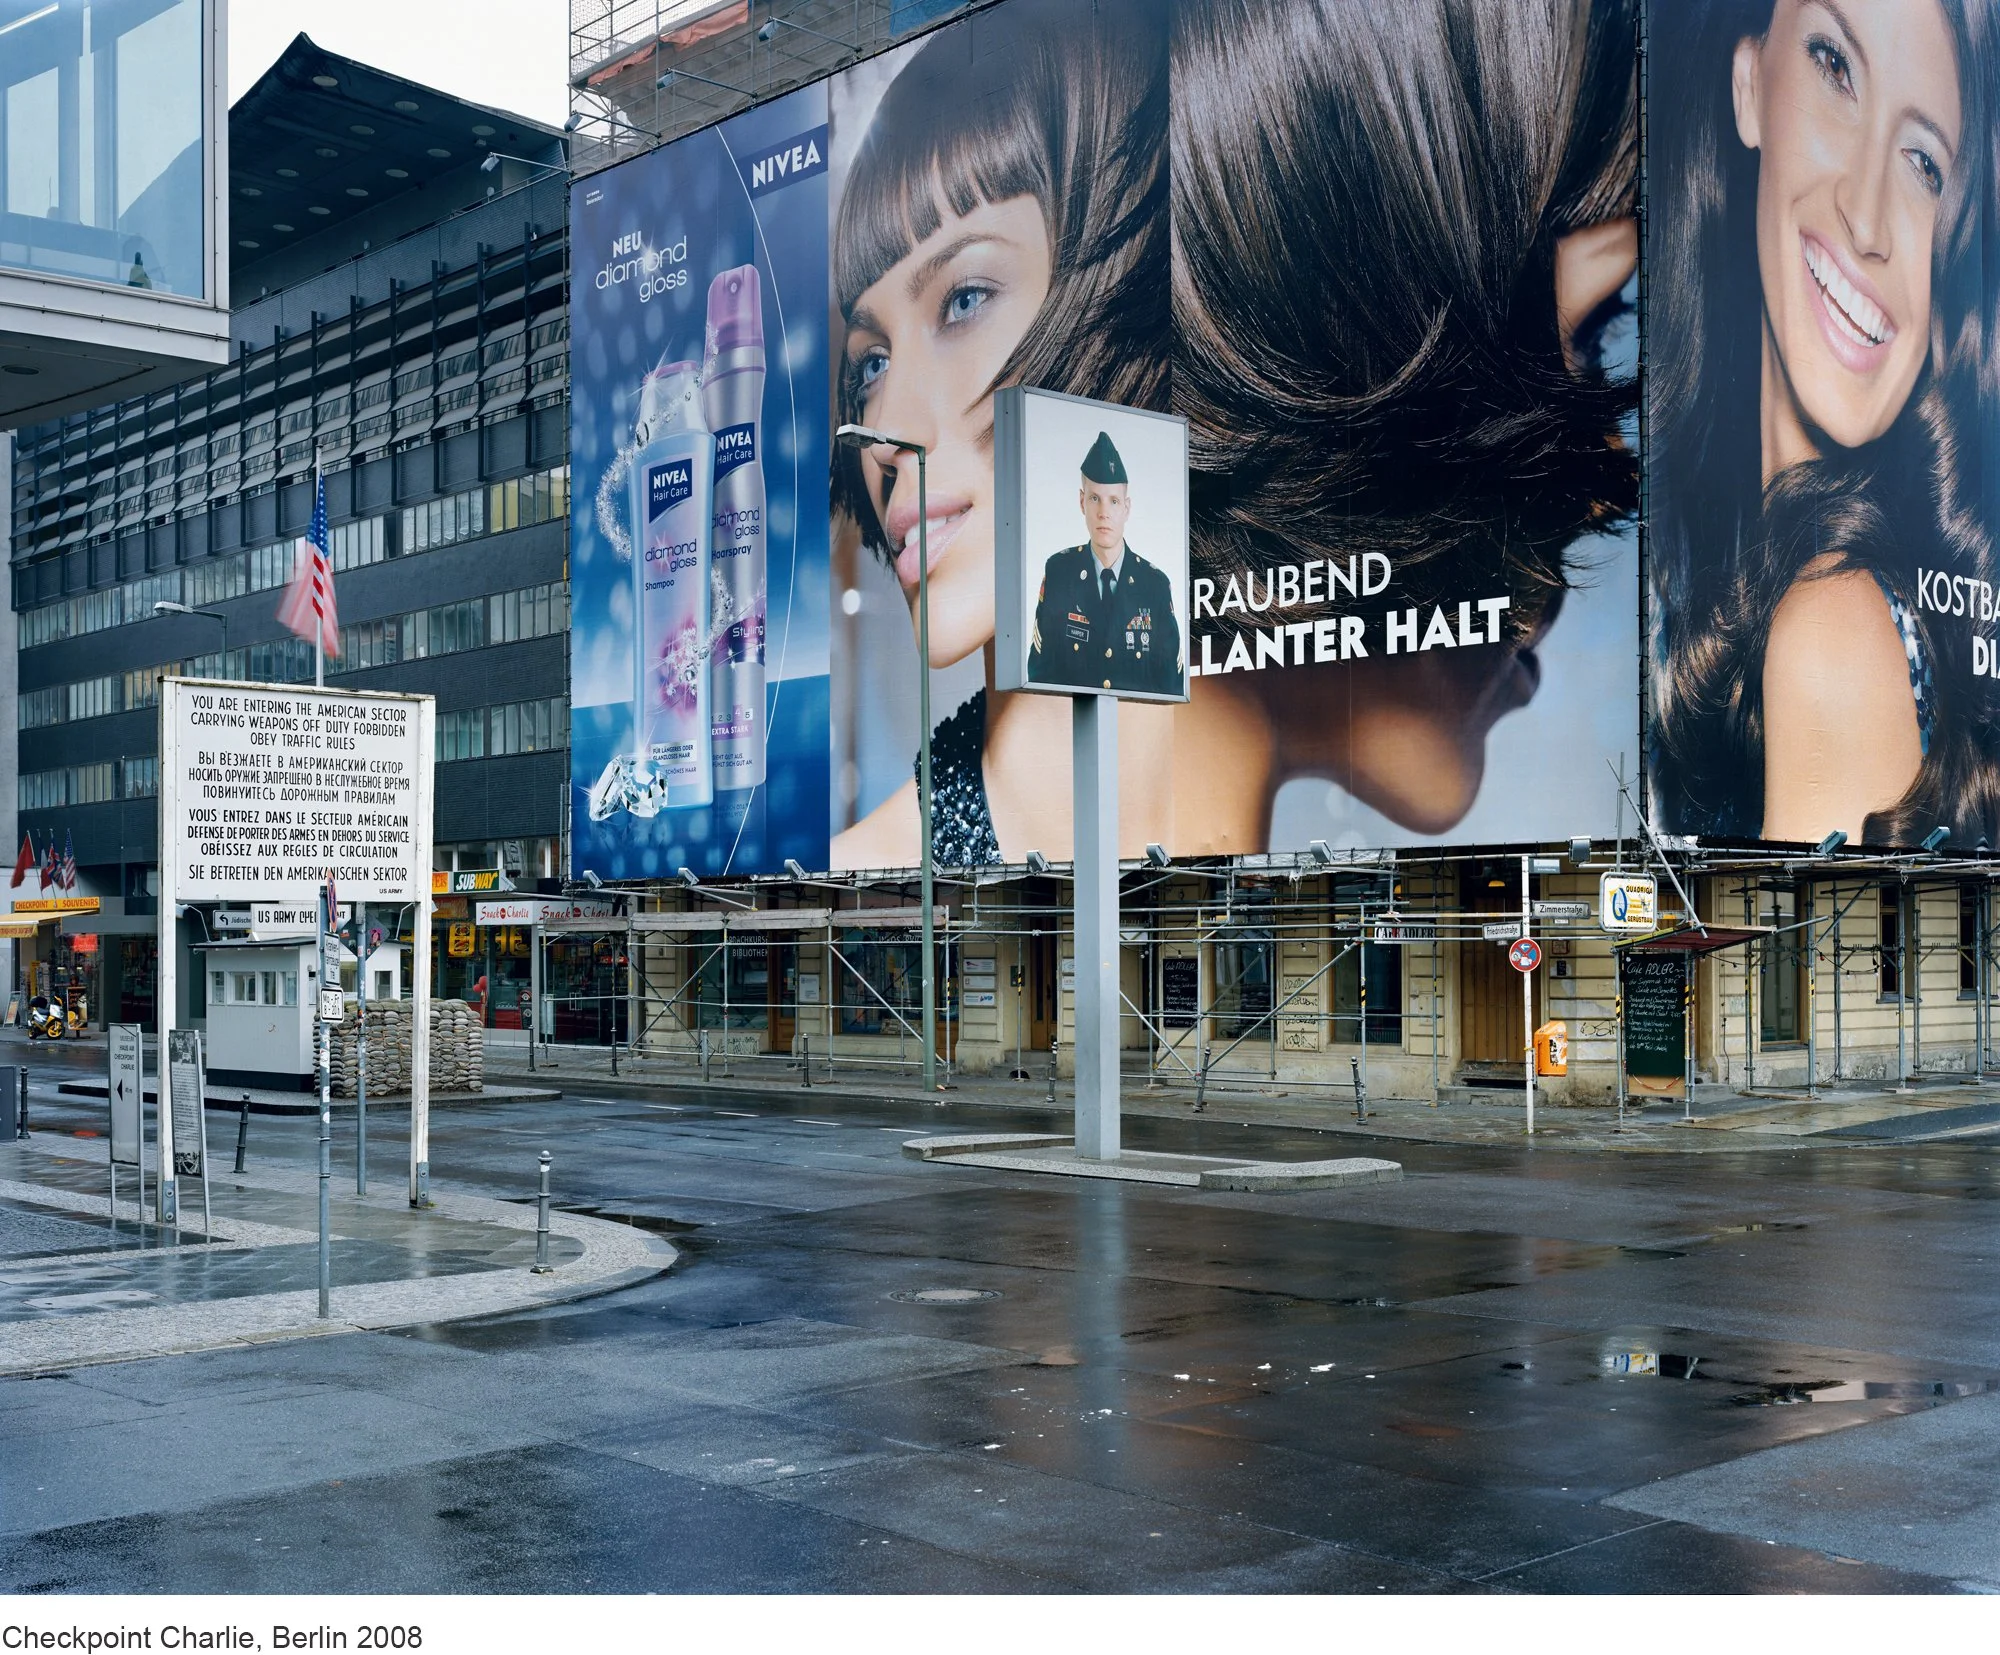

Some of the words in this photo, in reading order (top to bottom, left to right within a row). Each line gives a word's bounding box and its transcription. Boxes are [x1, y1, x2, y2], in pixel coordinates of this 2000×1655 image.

[752, 139, 821, 189] NIVEA
[613, 230, 641, 258] NEU
[596, 235, 687, 289] diamond
[640, 269, 688, 303] gloss
[717, 430, 752, 452] NIVEA
[716, 453, 733, 465] Hair
[734, 449, 752, 459] Care
[653, 468, 688, 489] NIVEA
[653, 490, 669, 502] Hair
[670, 486, 688, 498] Care
[712, 507, 760, 530] diamond
[734, 525, 760, 539] gloss
[645, 539, 697, 562] diamond
[712, 545, 752, 560] Haarspray
[670, 556, 697, 572] gloss
[645, 579, 675, 591] Shampoo
[1194, 552, 1392, 619] RAUBEND
[732, 625, 765, 639] Styling
[1386, 596, 1511, 655] HALT
[1972, 635, 2000, 680] DI
[192, 695, 213, 710] YOU
[219, 697, 238, 711] ARE
[244, 698, 291, 715] ENTERING
[295, 702, 312, 716] THE
[317, 704, 366, 719] AMERICAN
[371, 707, 407, 722] SECTOR
[718, 714, 723, 722] 2
[727, 713, 731, 721] 3
[745, 711, 751, 719] 5
[191, 712, 245, 728] CARRYING
[249, 715, 299, 731] WEAPONS
[303, 719, 321, 732] OFF
[326, 720, 350, 734] DUTY
[354, 722, 406, 738] FORBIDDEN
[712, 727, 730, 736] EXTRA
[731, 724, 749, 734] STARK
[250, 732, 277, 746] OBEY
[282, 734, 322, 748] TRAFFIC
[326, 736, 356, 751] RULES
[198, 751, 215, 765] ВЫ
[277, 755, 284, 768] В
[289, 756, 366, 773] АМЕРИКАНСКИЙ
[370, 760, 404, 774] СЕКТОР
[189, 767, 222, 782] НОСИТЬ
[225, 769, 260, 783] ОРУЖИЕ
[316, 773, 322, 786] В
[325, 773, 382, 789] НЕСЛУЖЕБНОЕ
[385, 776, 410, 791] ВРЕМЯ
[280, 787, 339, 802] ДОРОЖНЫМ
[344, 790, 395, 805] ПРАВИЛАМ
[189, 808, 218, 822] VOUS
[223, 810, 260, 824] ENTREZ
[266, 811, 292, 825] DANS
[297, 812, 306, 824] LE
[311, 812, 353, 826] SECTEUR
[188, 825, 225, 839] DEFENSE
[227, 826, 238, 840] DE
[239, 827, 270, 841] PORTER
[271, 828, 287, 841] DES
[289, 828, 316, 842] ARMES
[318, 829, 329, 842] EN
[332, 829, 362, 843] DEHORS
[365, 830, 376, 843] DU
[378, 830, 411, 844] SERVICE
[201, 840, 252, 857] OBÉISSEZ
[257, 844, 278, 857] AUX
[283, 844, 318, 858] REGLES
[323, 845, 334, 858] DE
[339, 845, 398, 859] CIRCULATION
[189, 864, 205, 880] SIE
[211, 865, 259, 881] BETRETEN
[264, 866, 283, 881] DEN
[373, 866, 408, 881] SEKTOR
[455, 871, 499, 891] SUBWAY
[1625, 885, 1653, 894] QUADRIGA
[15, 900, 49, 910] CHECKPOINT
[62, 898, 99, 907] SOUVENIRS
[480, 906, 499, 921] Snack
[507, 905, 529, 919] Charlie
[539, 905, 570, 921] Snack
[1539, 904, 1583, 915] Zimmerstraße
[258, 910, 270, 923] US
[273, 911, 296, 924] ARMY
[1402, 926, 1434, 938] ADLER
[1486, 925, 1518, 936] Friedrichstraße
[1645, 962, 1675, 976] ADLER
